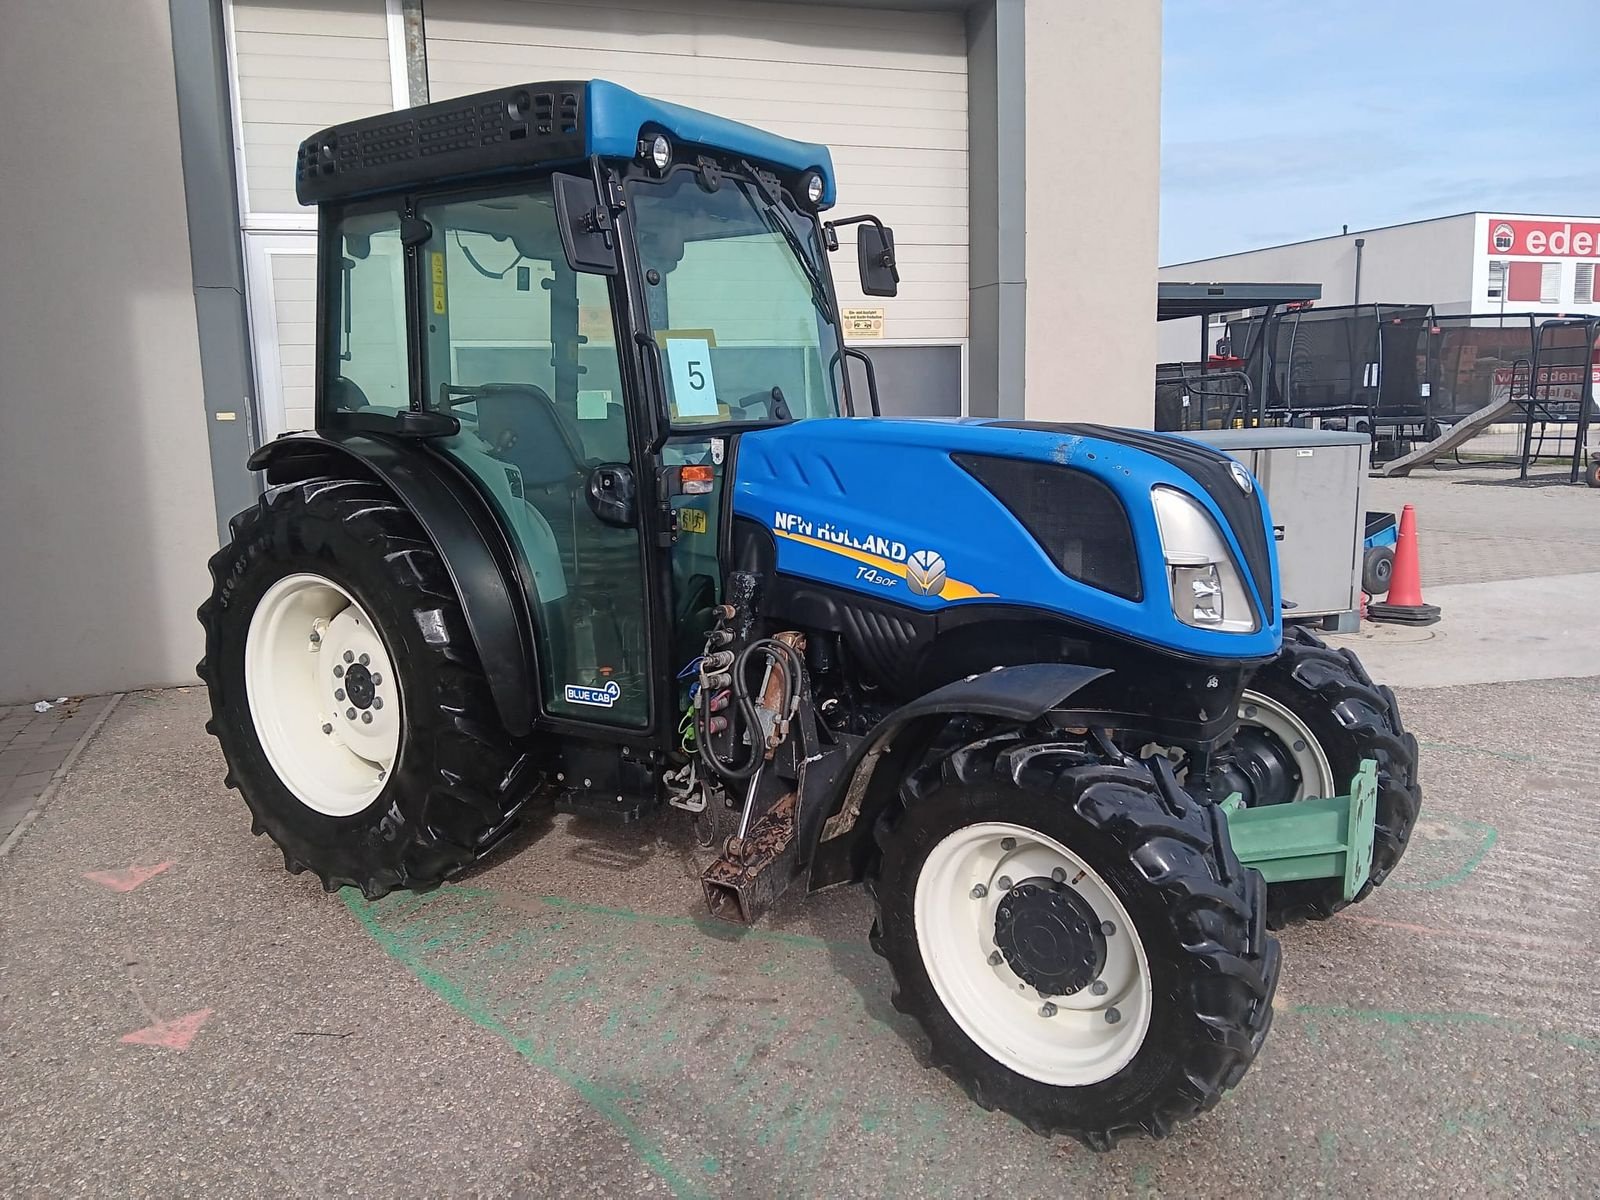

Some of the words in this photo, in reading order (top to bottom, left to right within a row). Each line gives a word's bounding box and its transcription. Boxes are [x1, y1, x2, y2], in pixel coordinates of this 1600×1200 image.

[1526, 224, 1600, 255] ede
[688, 361, 705, 390] 5
[568, 689, 590, 700] BLUE
[592, 692, 610, 703] CAB
[607, 685, 617, 695] 4
